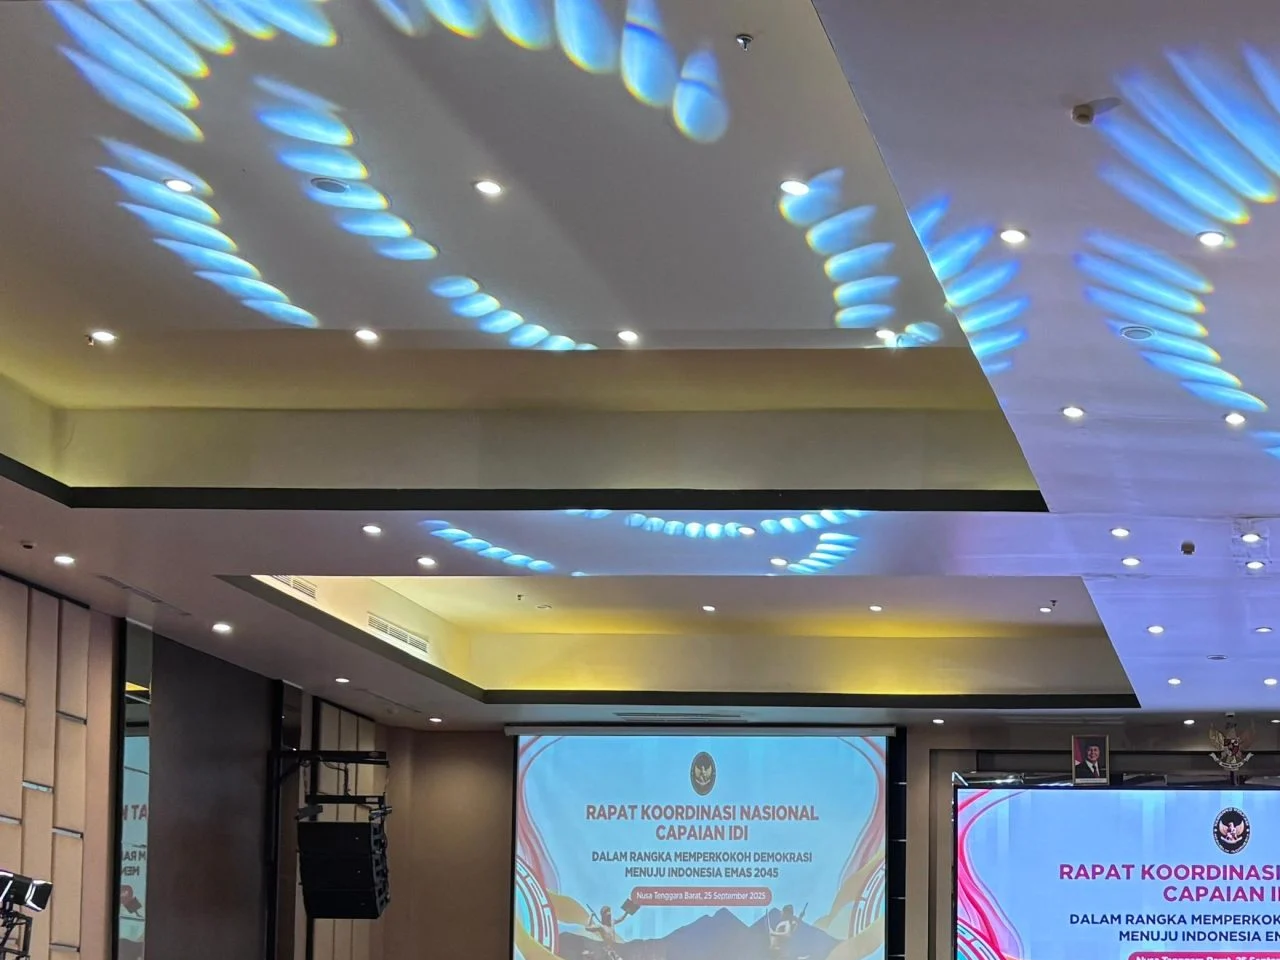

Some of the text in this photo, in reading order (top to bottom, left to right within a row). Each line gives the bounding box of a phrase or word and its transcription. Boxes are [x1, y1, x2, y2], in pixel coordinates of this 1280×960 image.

[586, 805, 819, 821] RAPAT KOORDINASI NASIONAL
[656, 825, 748, 841] CAPAIAN IDI
[591, 852, 812, 862] DALAM RANGKA MEMPERKOKOH DEMOKRASI
[625, 867, 779, 878] MENUJU INDONESIA EMAS 2045
[1059, 864, 1135, 881] RAPAT
[1141, 864, 1280, 881] KOORDINASI
[636, 892, 653, 901] Nusa
[654, 892, 683, 901] Tenggara
[713, 892, 748, 901] September
[1163, 886, 1264, 902] CAPAIAN
[1070, 914, 1121, 925] DALAM
[1125, 914, 1187, 925] RANGKA
[1119, 931, 1178, 942] MENUJU
[1182, 931, 1261, 942] INDONESIA
